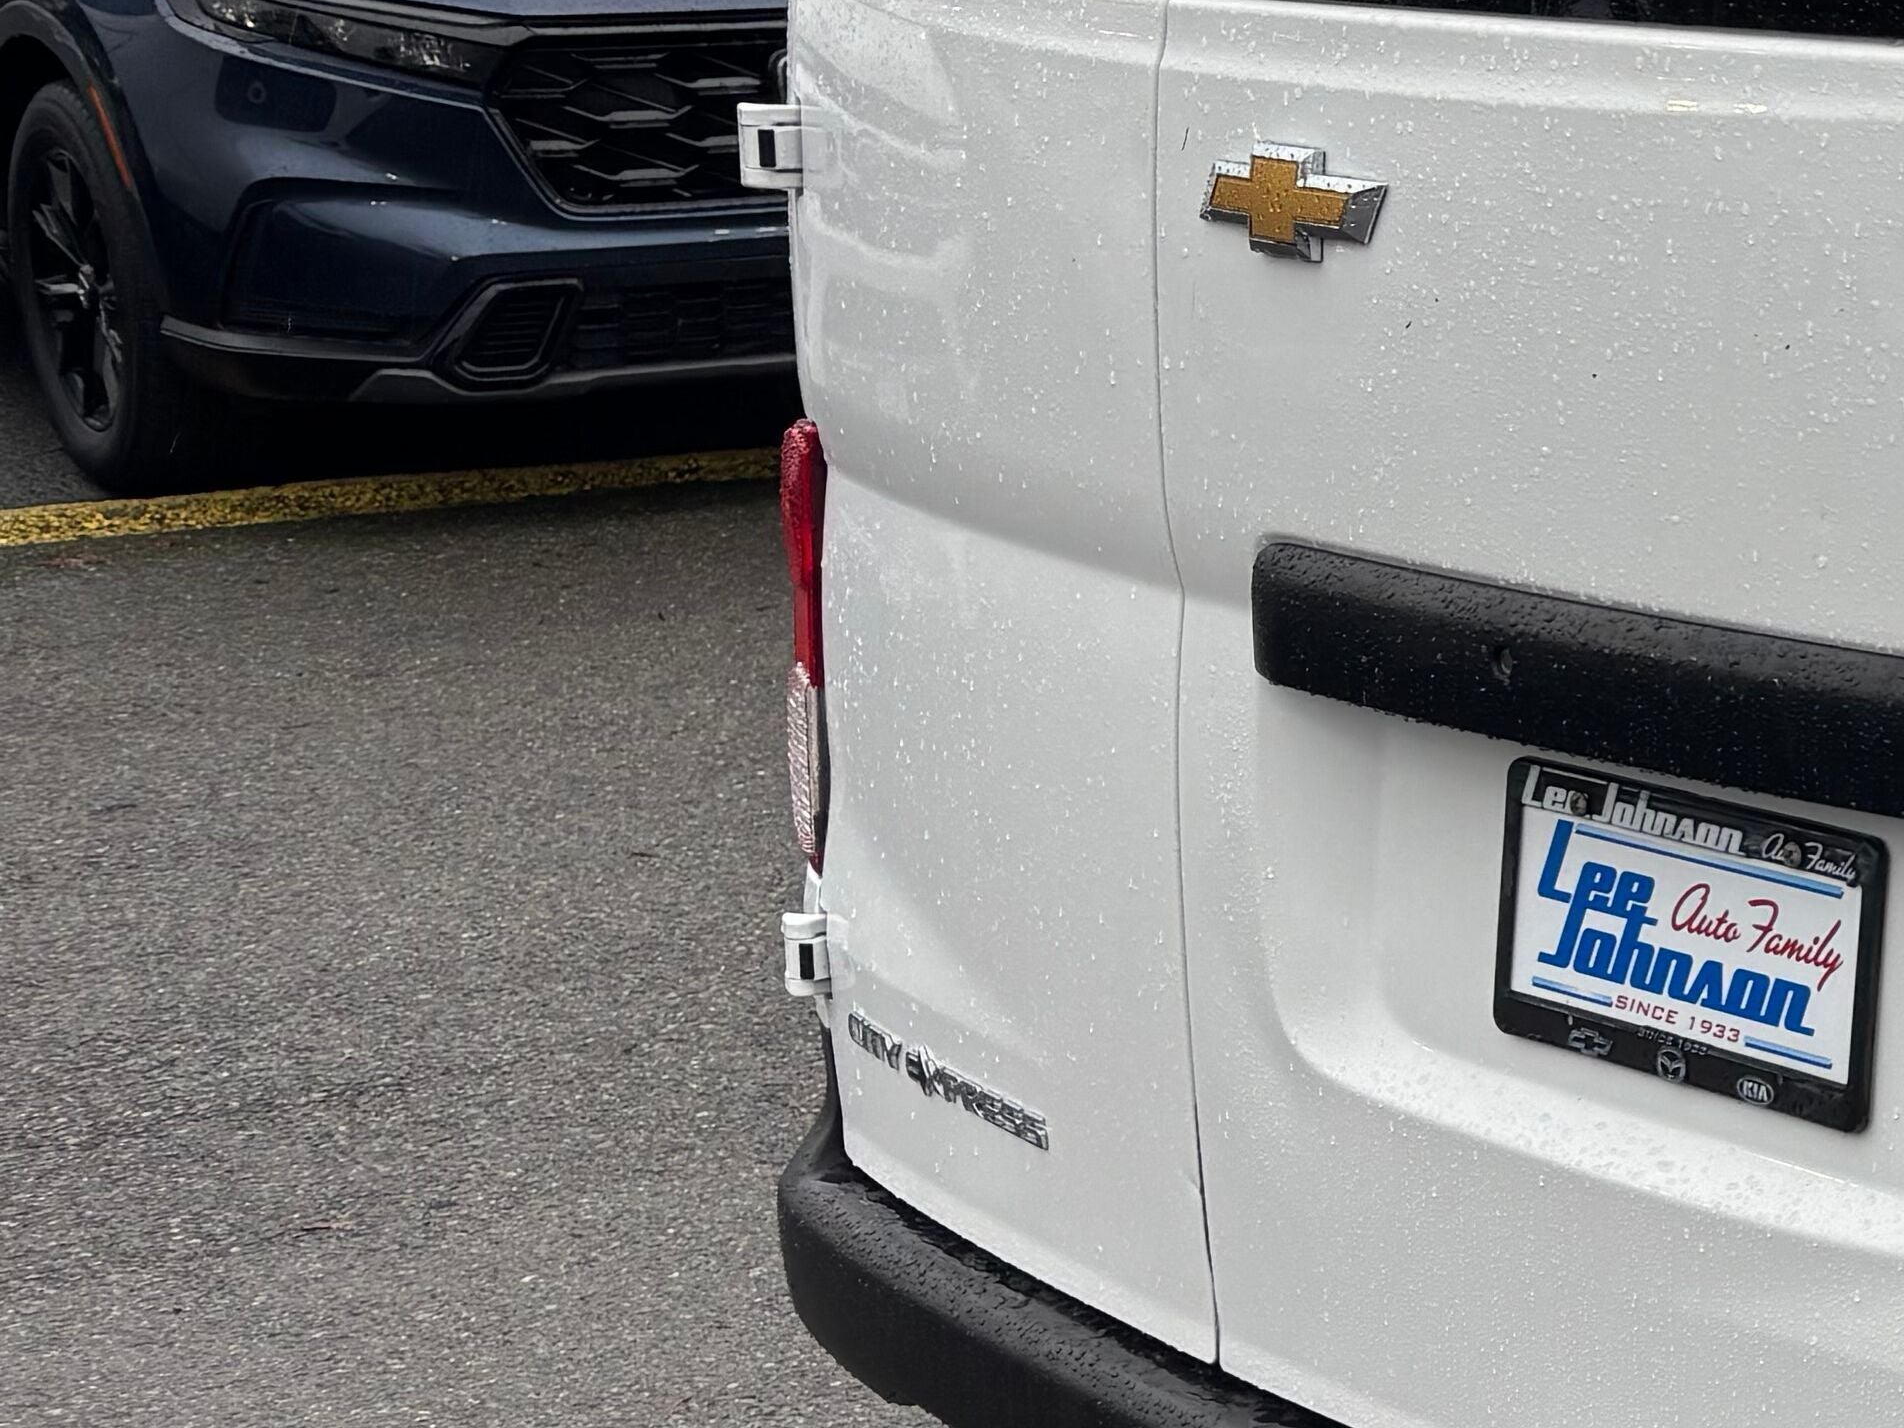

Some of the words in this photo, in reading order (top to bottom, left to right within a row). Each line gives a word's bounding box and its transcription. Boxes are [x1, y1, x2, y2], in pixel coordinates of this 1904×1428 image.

[1537, 819, 1657, 926] Lee
[1591, 782, 1747, 856] Johnson
[1804, 841, 1857, 884] Family
[1537, 904, 1815, 1037] Johnson
[1671, 883, 1741, 943] Auto
[1746, 898, 1844, 992] Family
[1614, 994, 1679, 1025] SINCE
[1688, 1015, 1741, 1043] 1933
[1742, 1079, 1769, 1102] KIA
